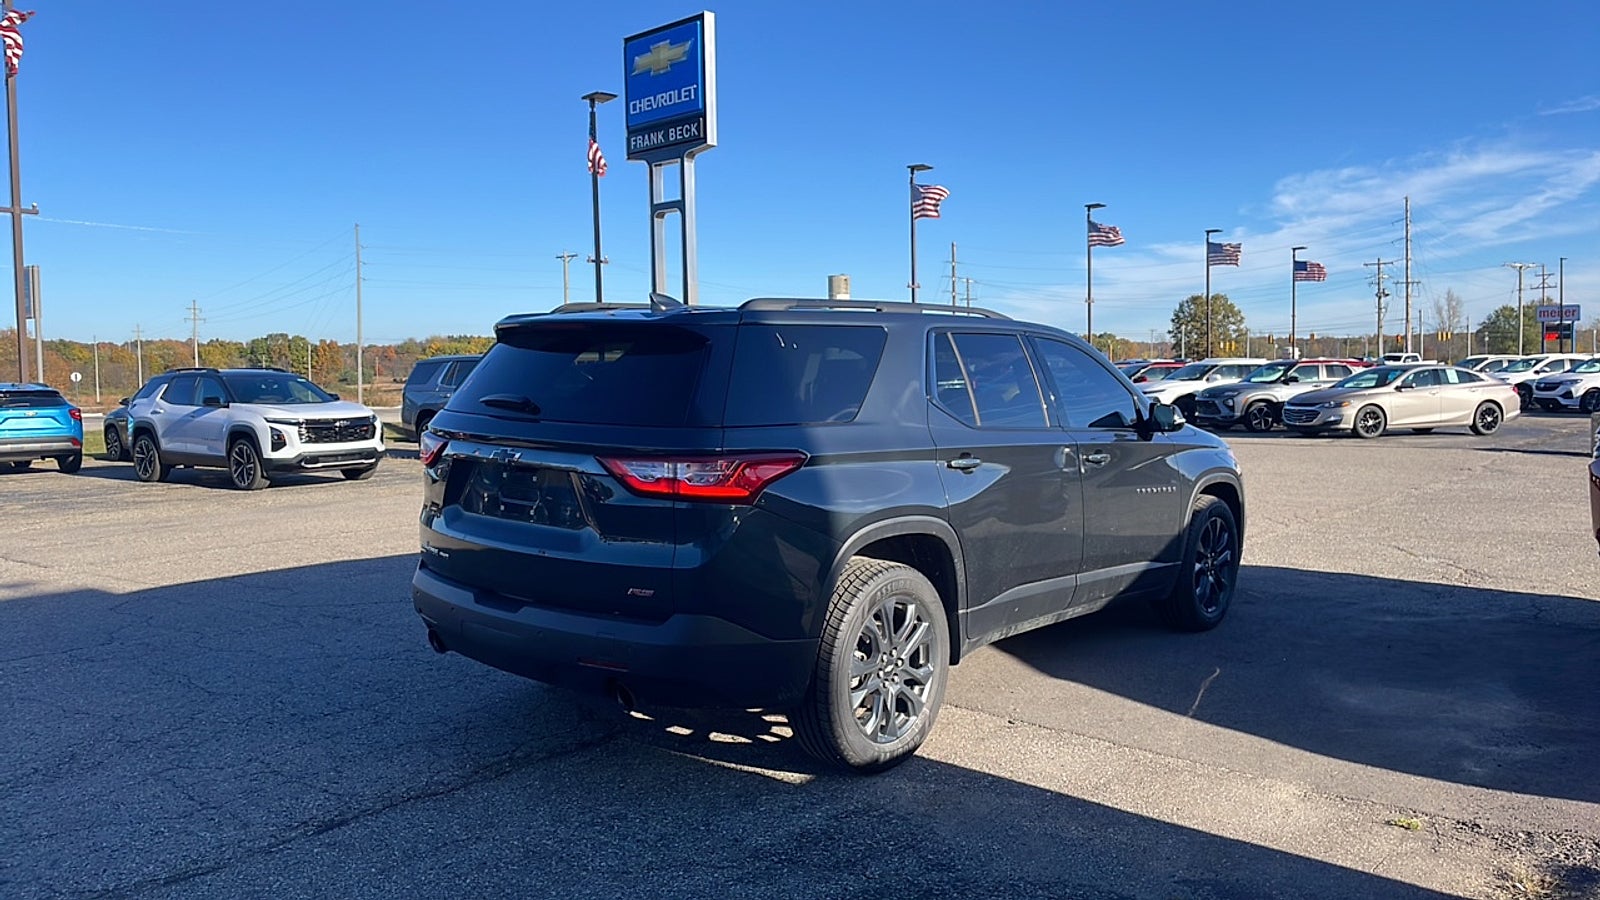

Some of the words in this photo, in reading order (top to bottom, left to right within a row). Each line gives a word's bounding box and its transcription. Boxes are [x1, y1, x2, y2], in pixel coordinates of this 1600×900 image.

[629, 85, 697, 115] CHEVROLET
[630, 130, 665, 150] FRANK
[669, 122, 699, 141] BECK
